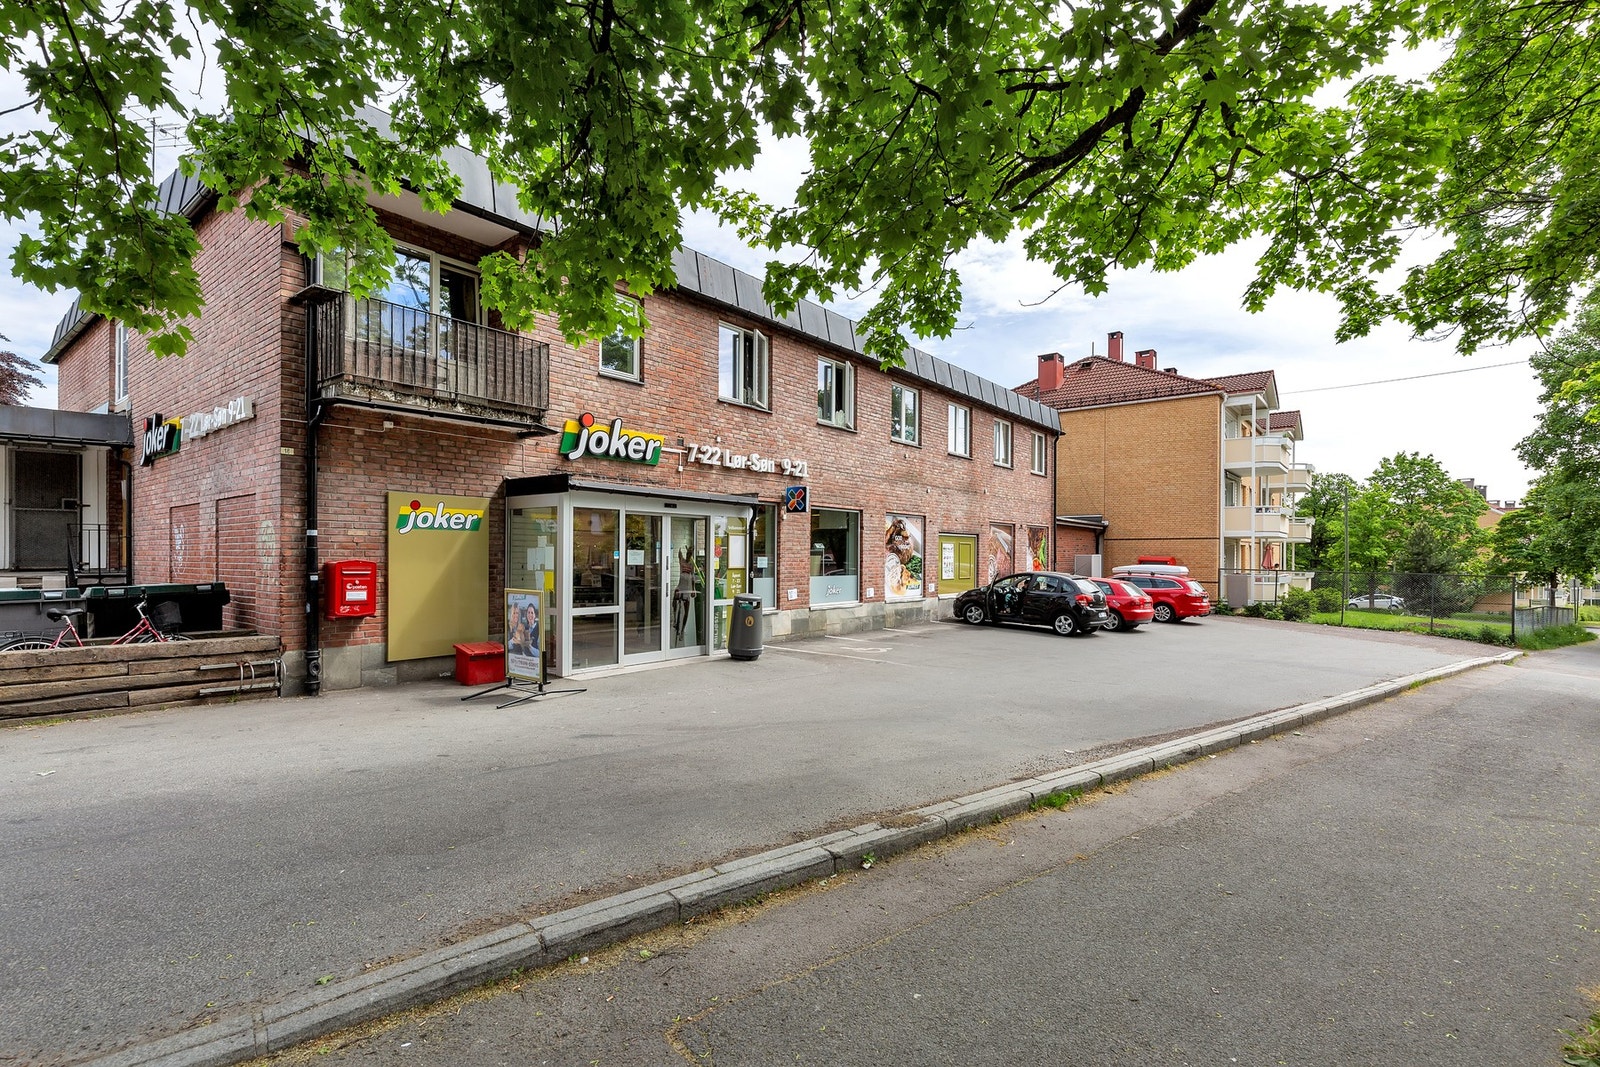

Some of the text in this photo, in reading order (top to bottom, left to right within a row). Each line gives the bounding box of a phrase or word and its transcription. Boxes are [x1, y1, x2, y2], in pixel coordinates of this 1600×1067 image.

[140, 413, 171, 467] joker
[567, 412, 661, 461] joker
[686, 443, 810, 478] 7-22 Lør-Søn 9-21
[398, 499, 479, 535] joker
[825, 585, 842, 597] joker
